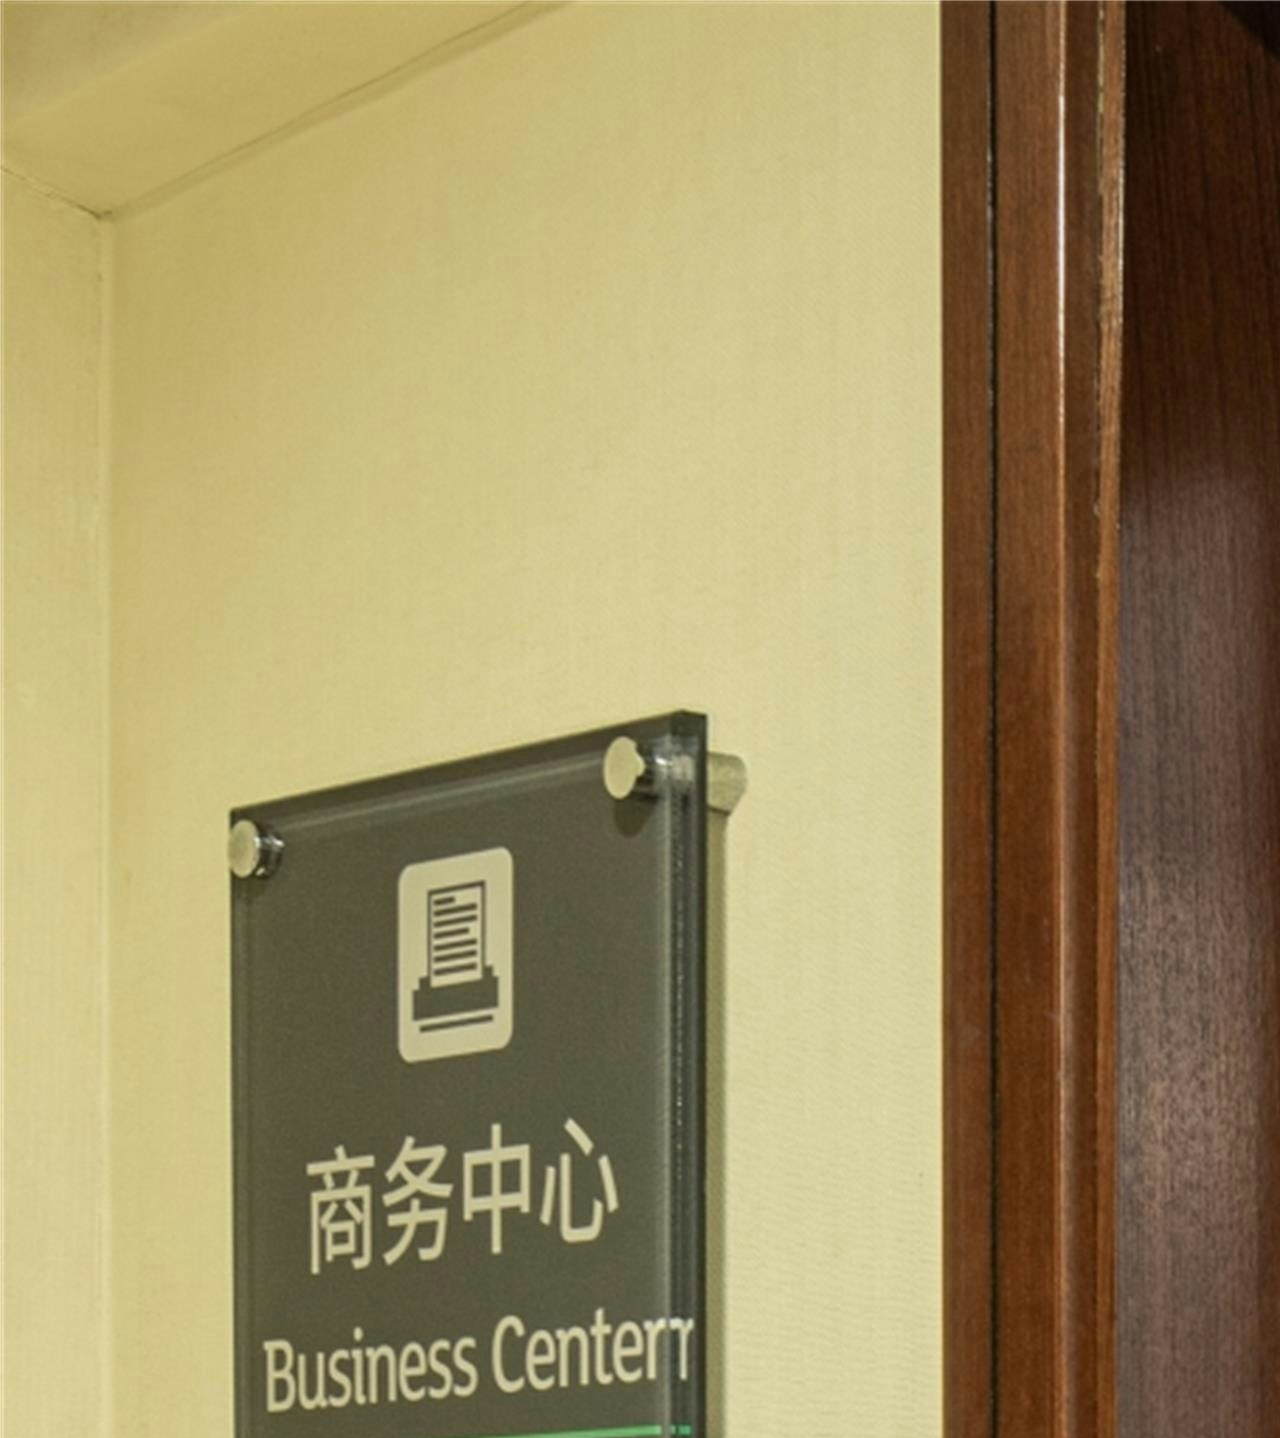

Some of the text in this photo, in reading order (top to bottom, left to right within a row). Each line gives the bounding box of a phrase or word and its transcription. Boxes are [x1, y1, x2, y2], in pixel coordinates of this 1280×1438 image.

[306, 1117, 619, 1275] 商务中心
[263, 1326, 479, 1412] Business
